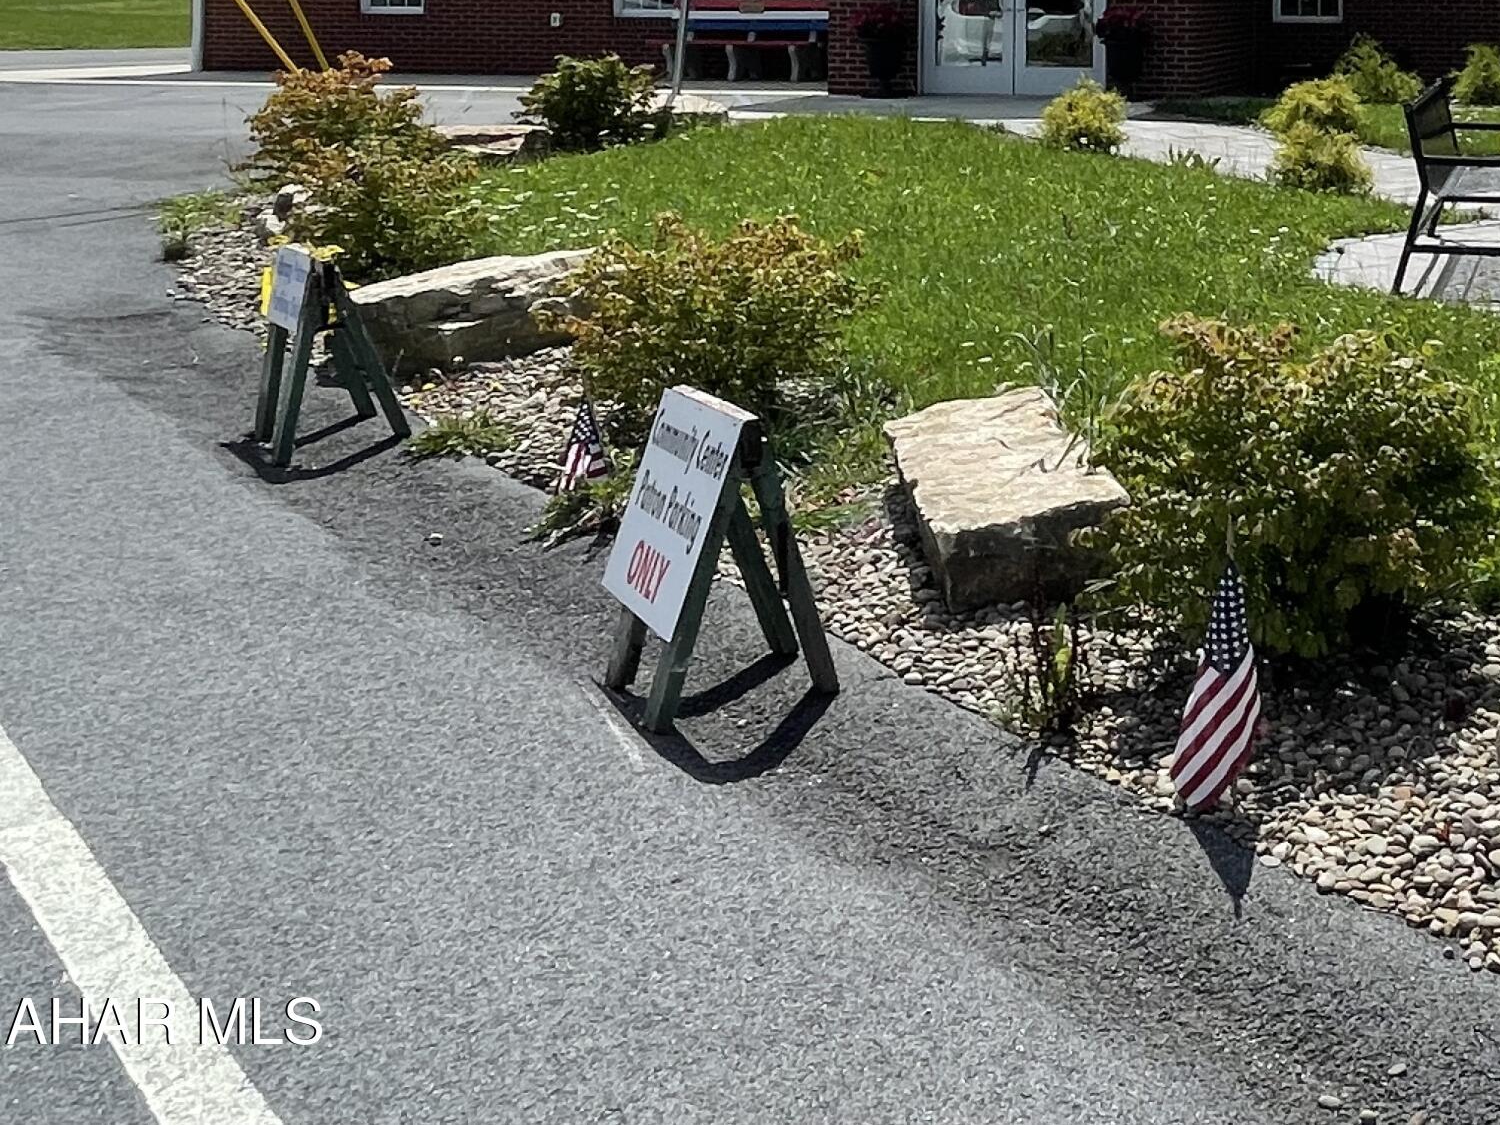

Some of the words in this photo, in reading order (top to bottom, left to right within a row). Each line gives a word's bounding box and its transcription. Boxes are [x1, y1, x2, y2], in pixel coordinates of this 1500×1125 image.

[696, 430, 729, 480] Center
[663, 485, 702, 555] Parking
[627, 539, 671, 604] ONLY
